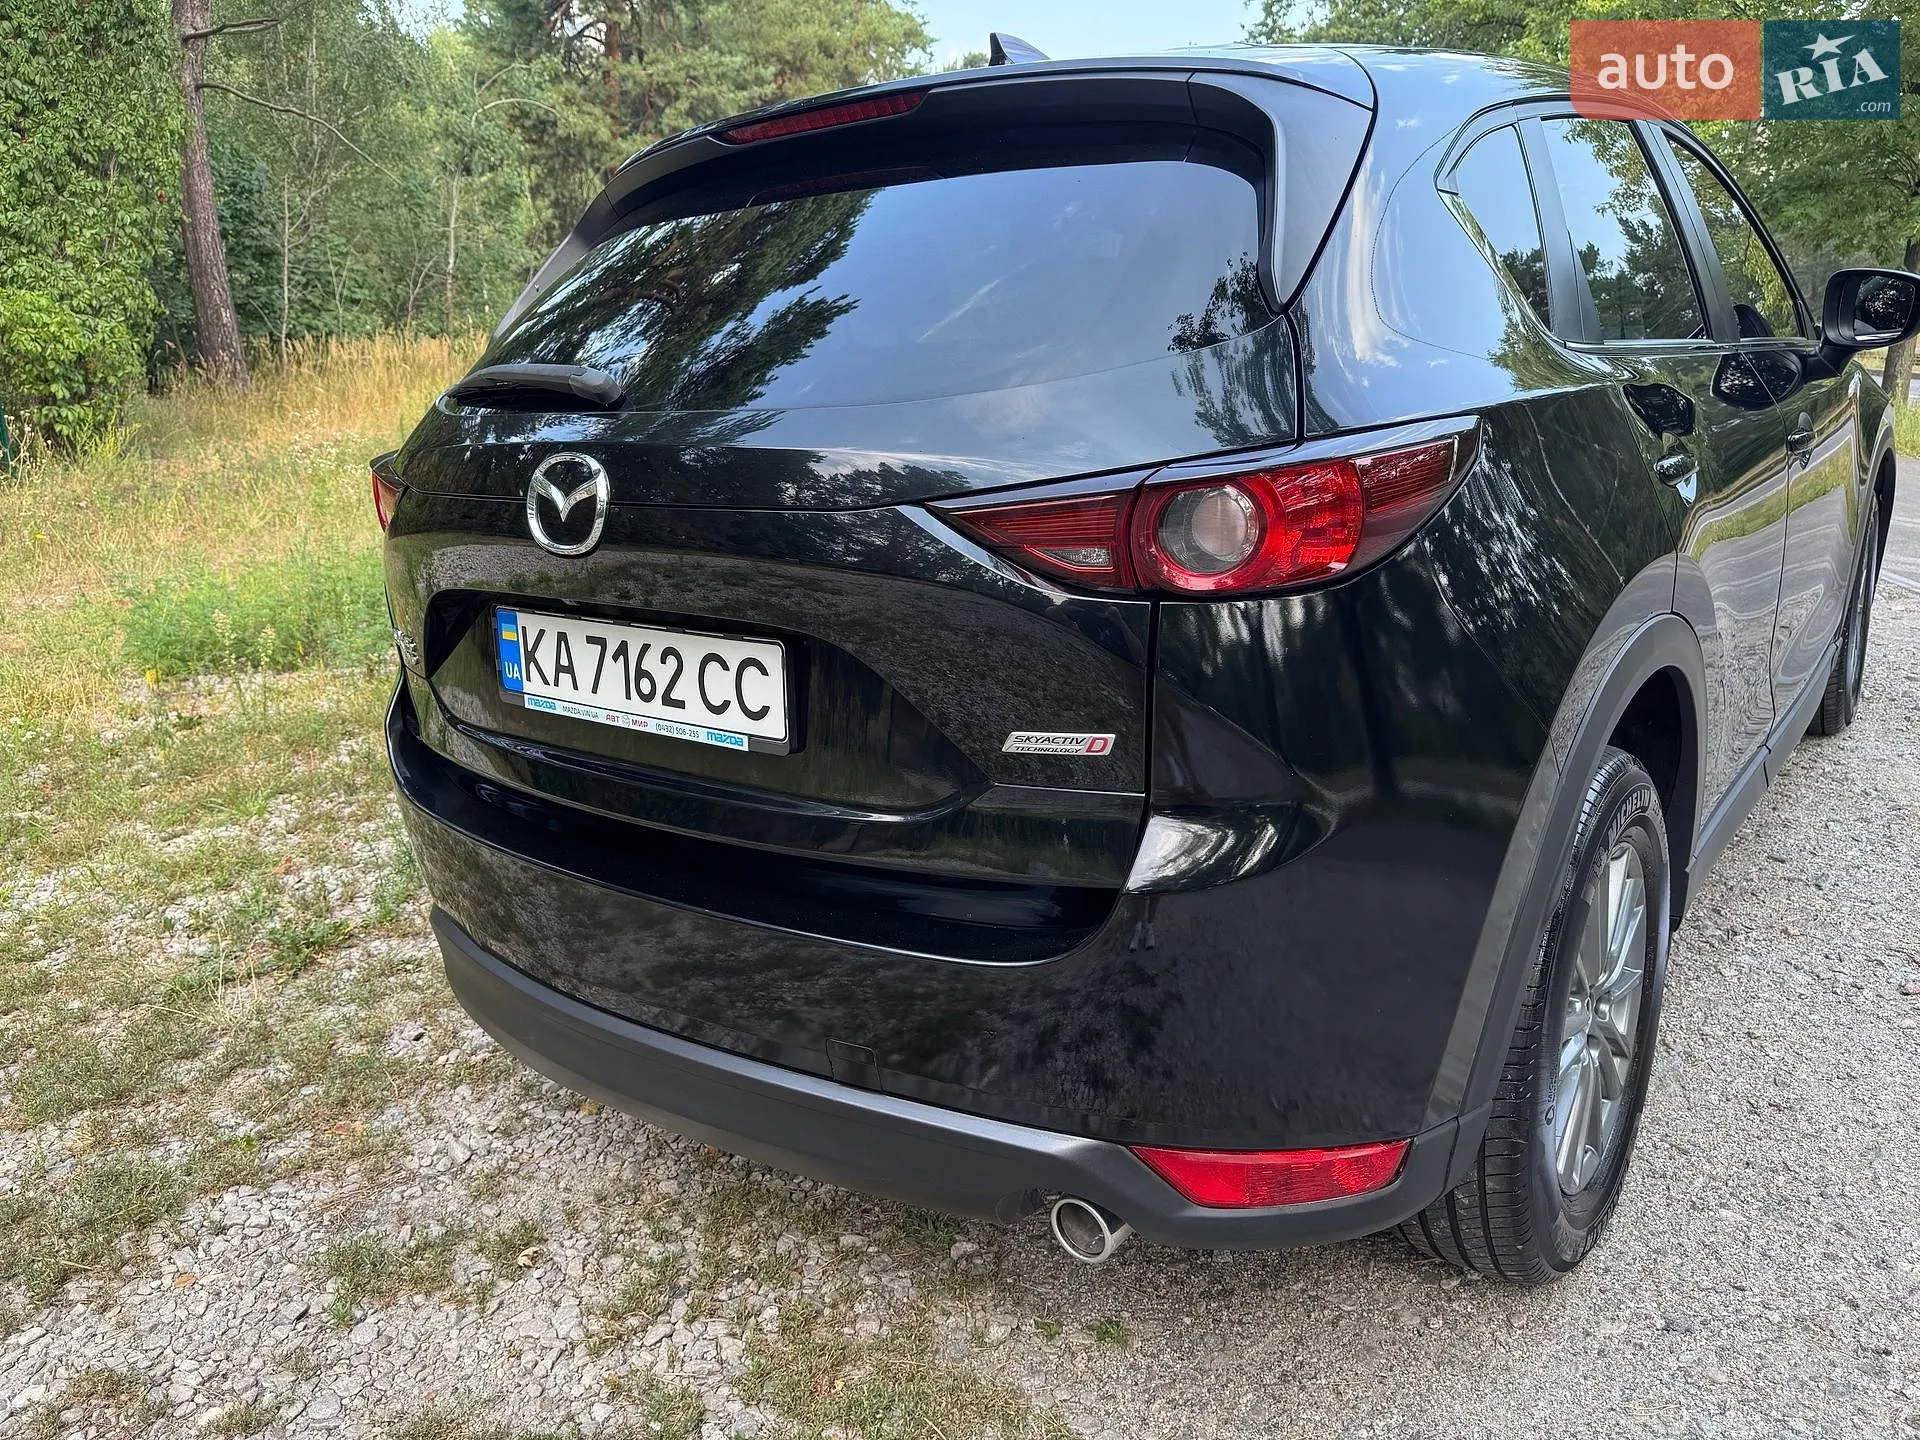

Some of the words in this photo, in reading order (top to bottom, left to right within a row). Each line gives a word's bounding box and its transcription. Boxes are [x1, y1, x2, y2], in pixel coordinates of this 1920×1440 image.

[505, 661, 521, 681] UA
[521, 625, 579, 691] KA
[585, 634, 686, 710] 7162
[697, 652, 771, 721] CC
[528, 698, 557, 711] mazda
[706, 731, 744, 747] mazda
[1013, 735, 1087, 745] SKYACTIV
[1085, 736, 1109, 754] D
[1014, 745, 1082, 754] TECHNOLOGY
[1608, 789, 1651, 850] MICHELIN
